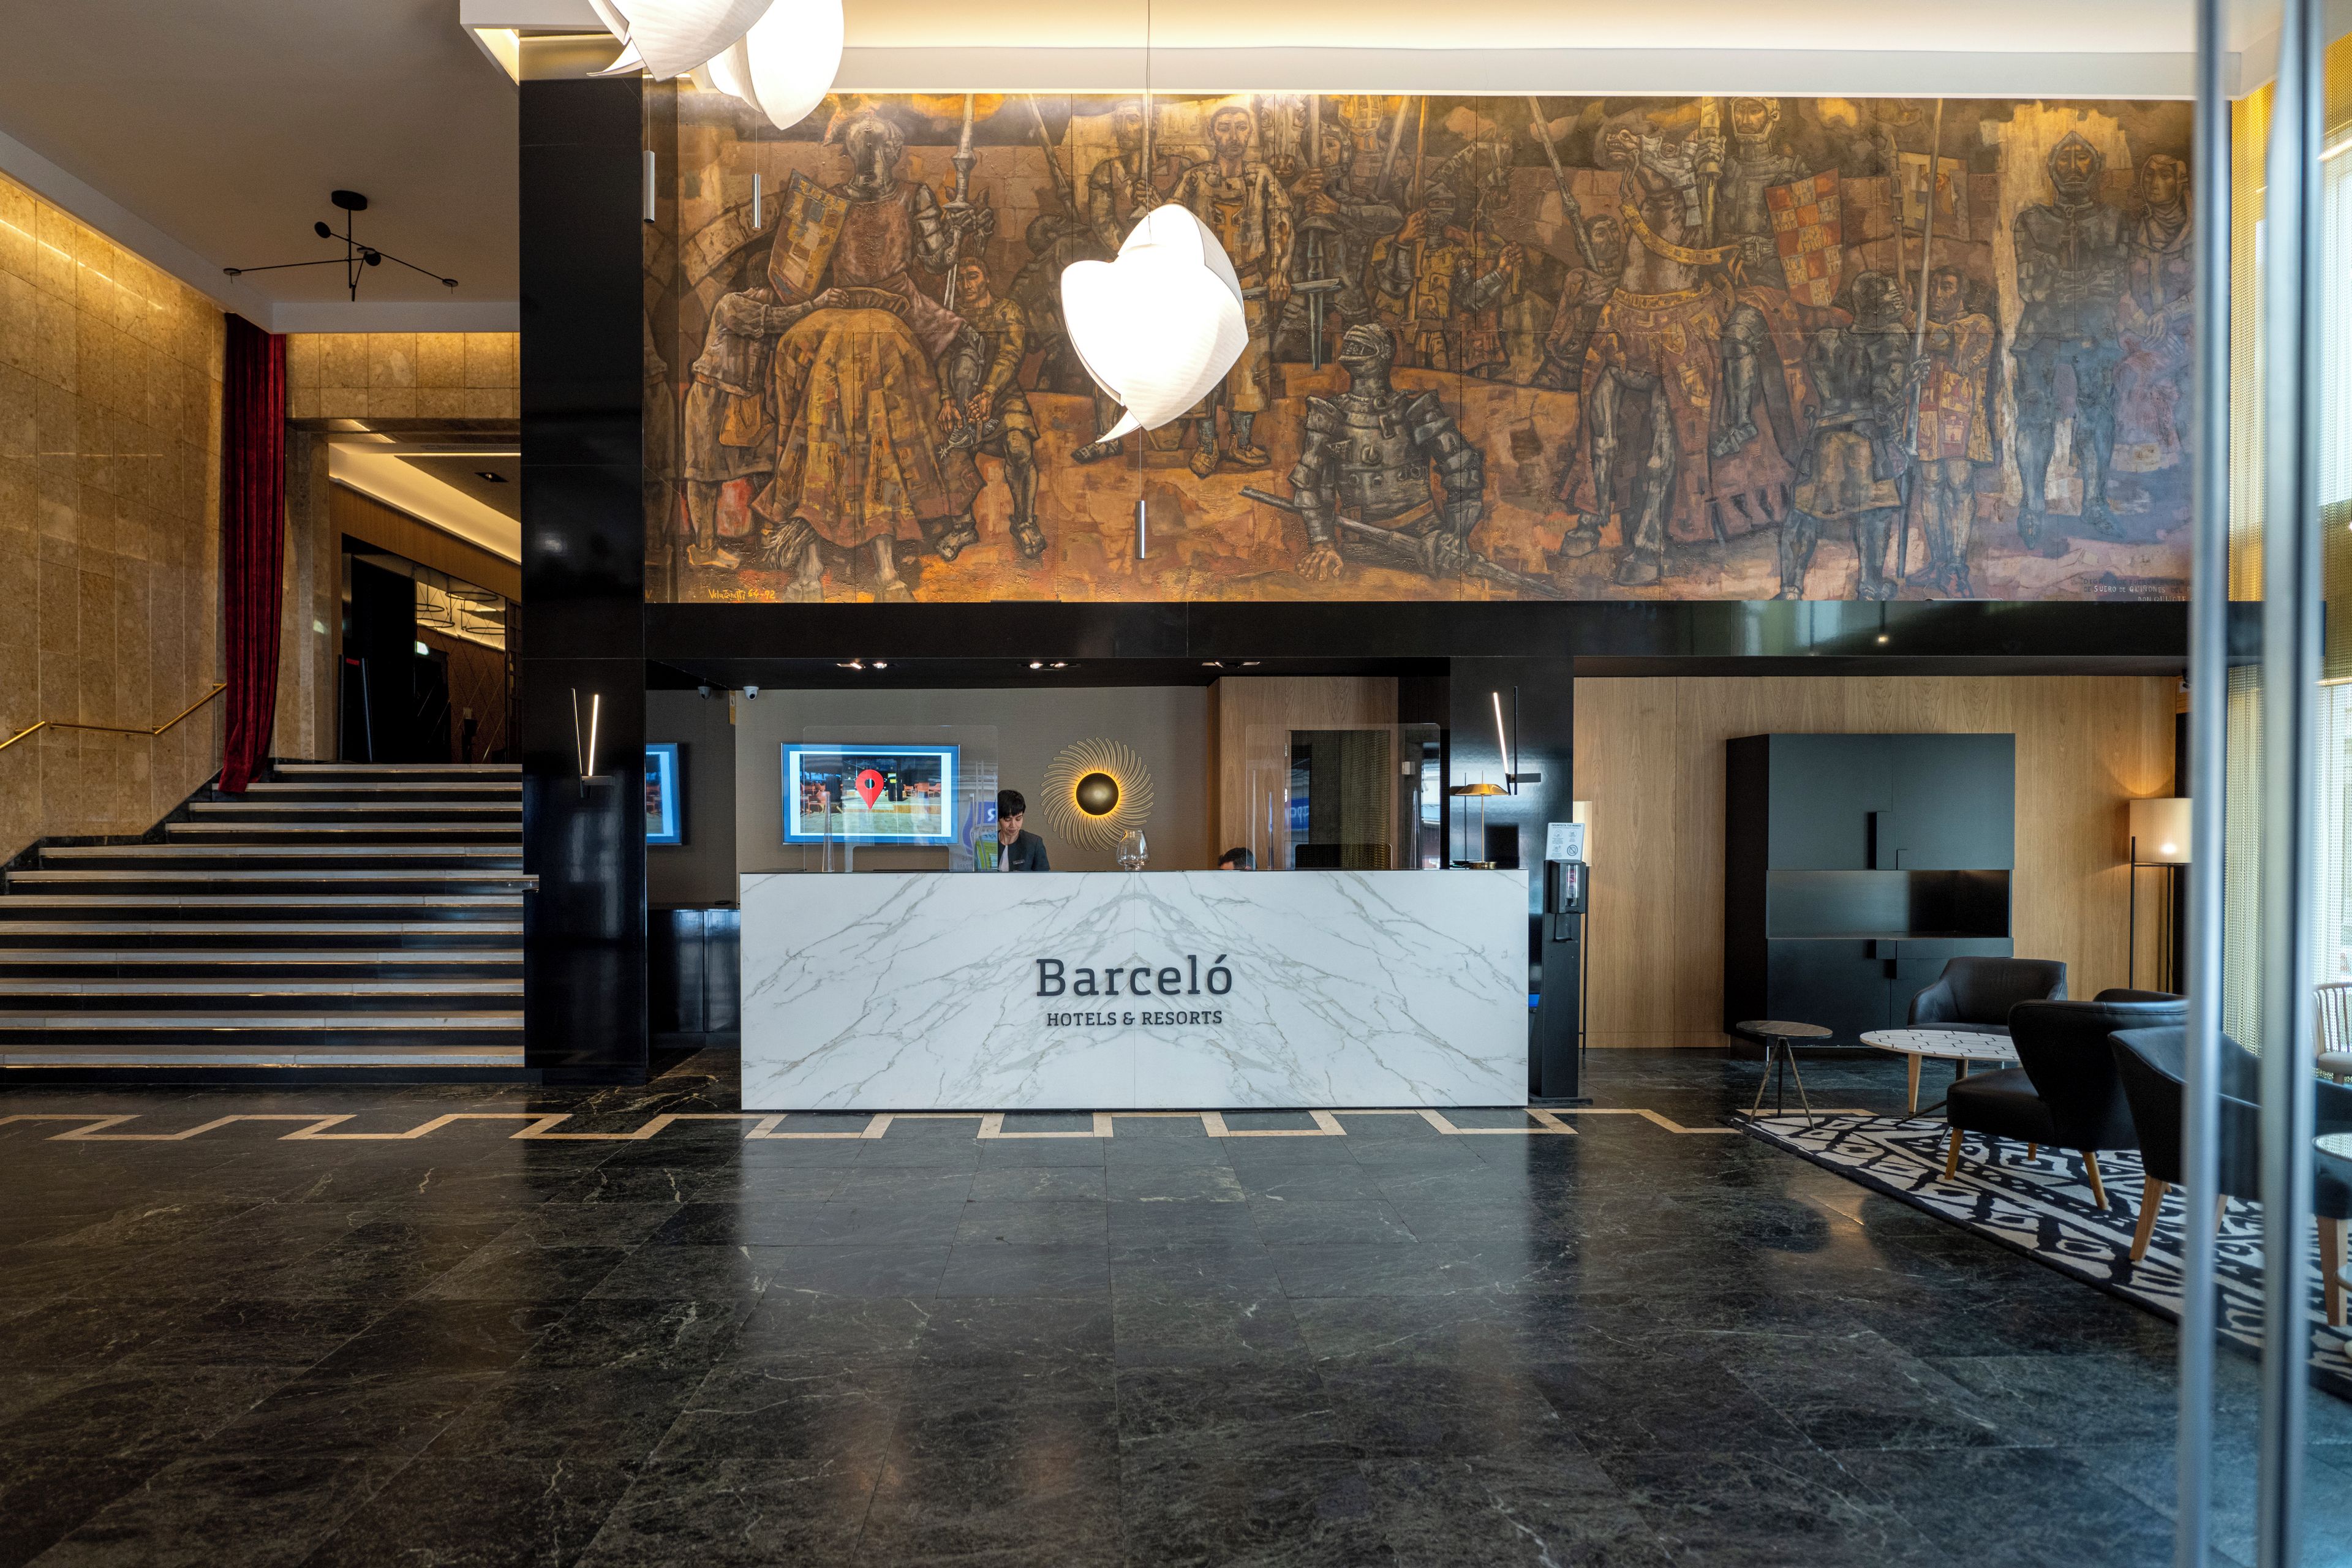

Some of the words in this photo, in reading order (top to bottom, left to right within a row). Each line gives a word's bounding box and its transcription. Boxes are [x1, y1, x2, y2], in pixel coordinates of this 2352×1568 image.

[2129, 585, 2166, 594] QUIÑONES
[1036, 954, 1232, 997] Barceló
[1047, 1012, 1117, 1026] HOTELS
[1123, 1012, 1136, 1025] &
[1142, 1011, 1223, 1025] RESORTS
